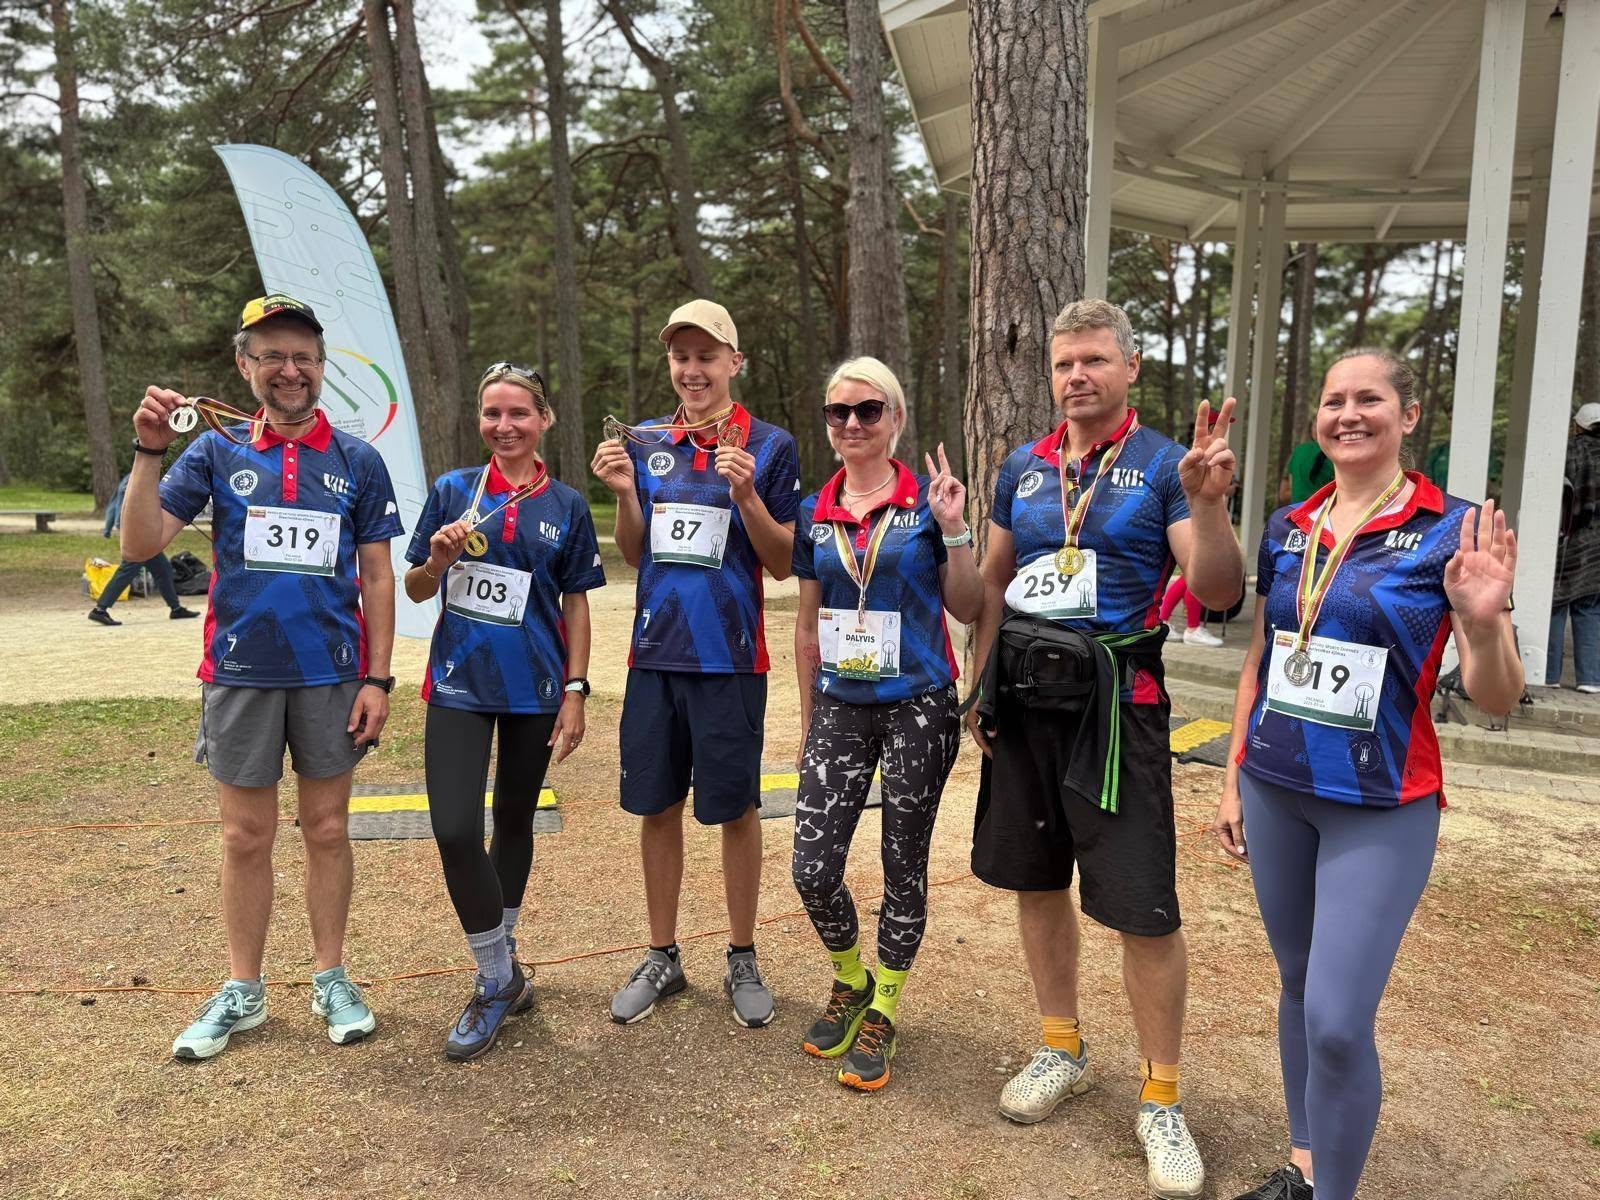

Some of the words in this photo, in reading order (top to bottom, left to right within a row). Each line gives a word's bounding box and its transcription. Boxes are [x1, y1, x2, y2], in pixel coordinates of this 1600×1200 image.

[266, 524, 320, 550] 319
[670, 519, 703, 541] 87
[466, 575, 508, 604] 103
[1023, 572, 1073, 599] 259
[642, 613, 651, 629] 7
[227, 637, 237, 652] 7
[845, 633, 876, 643] DALYVIS
[445, 664, 455, 678] 7
[1312, 660, 1350, 695] 19
[821, 680, 830, 694] 7
